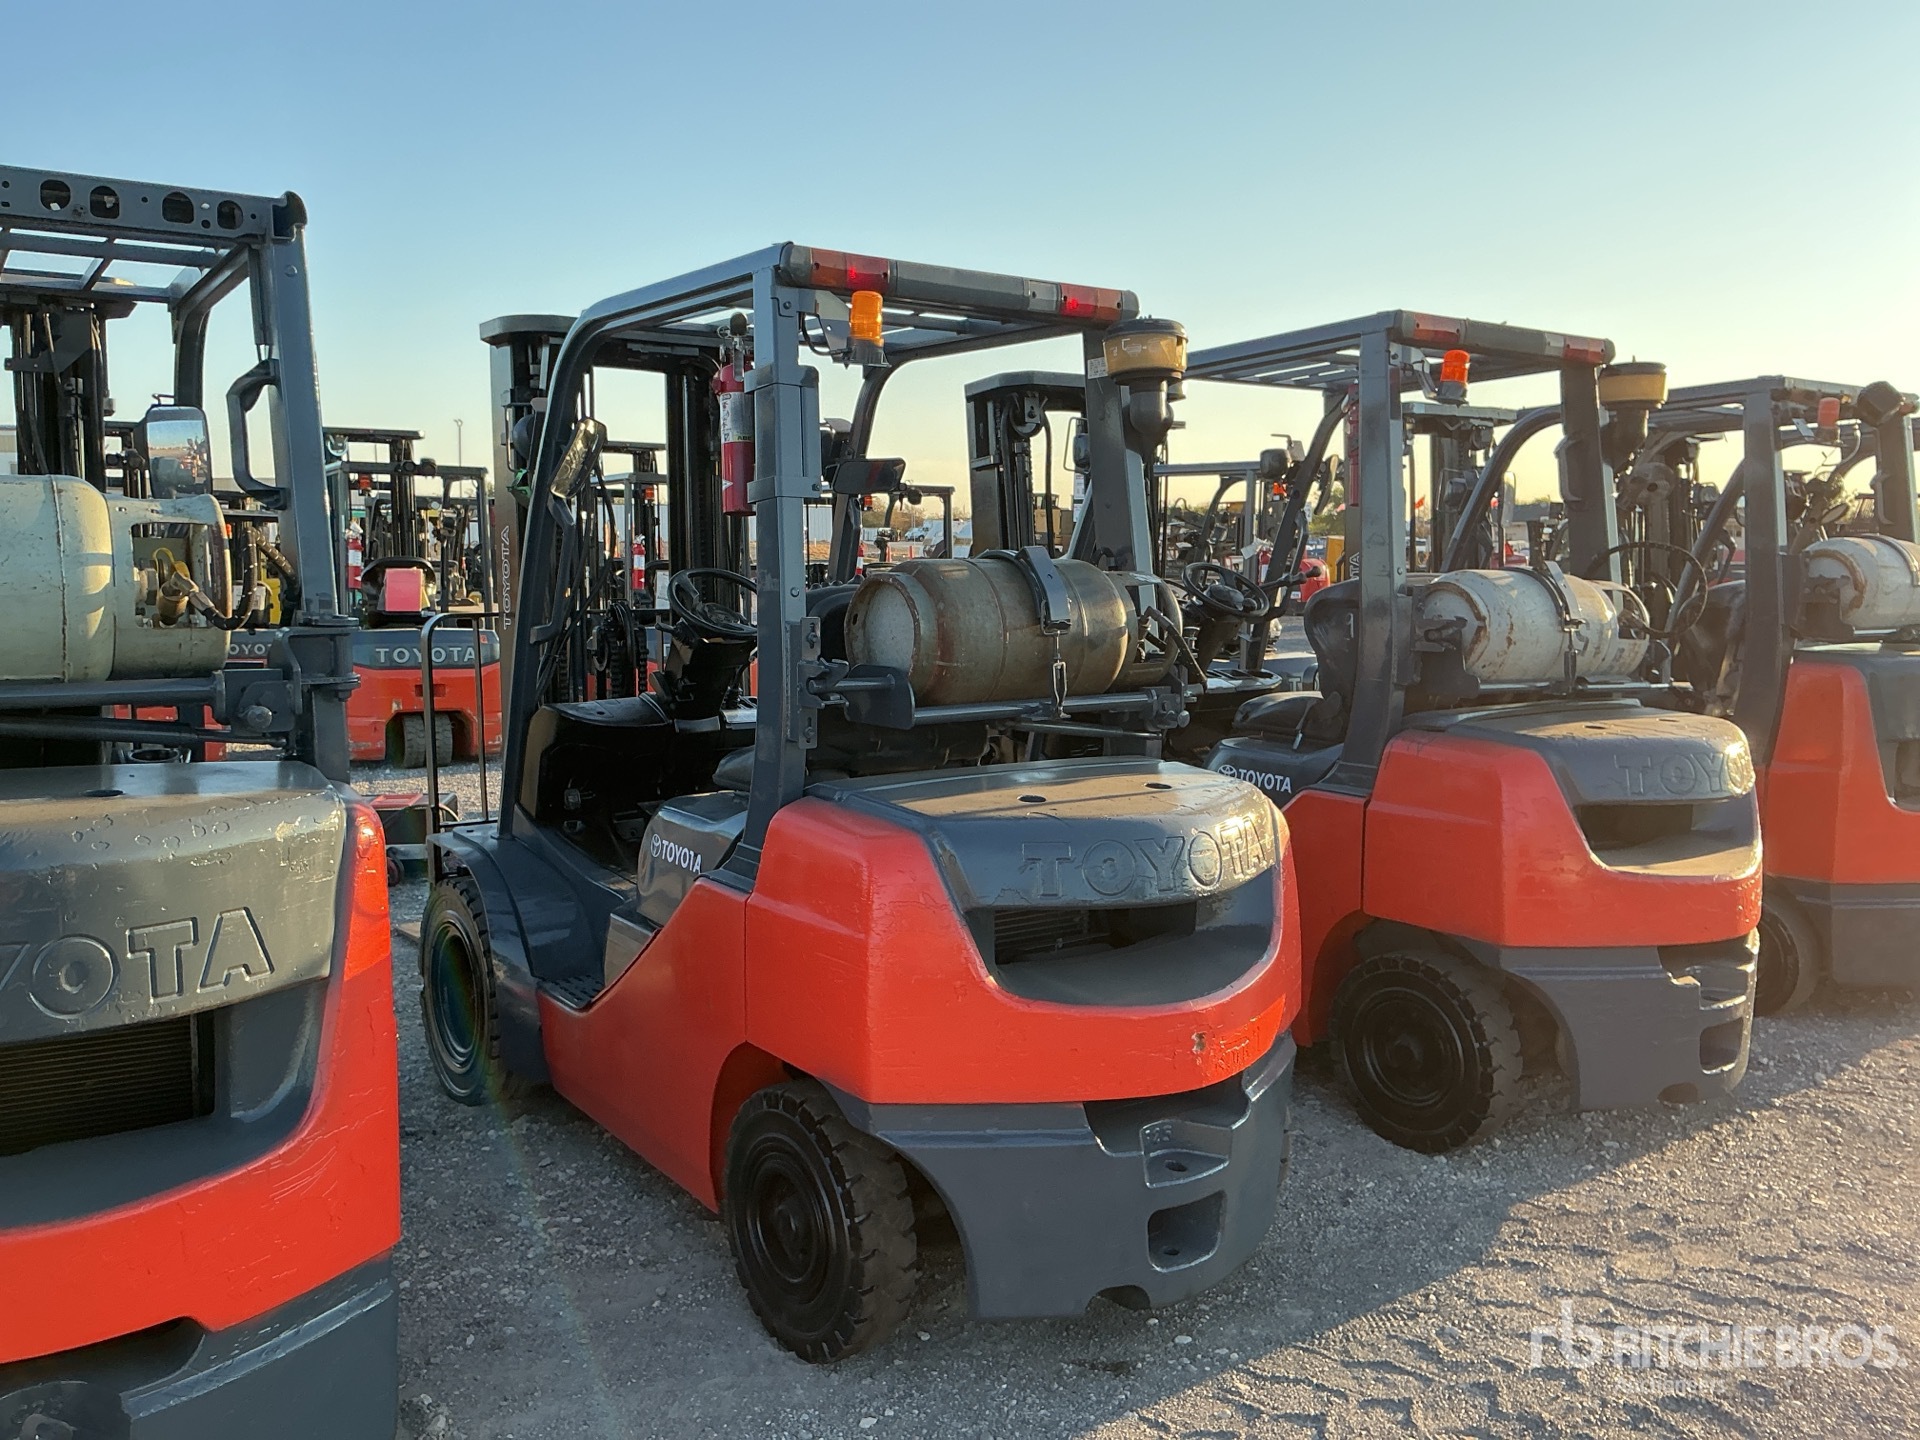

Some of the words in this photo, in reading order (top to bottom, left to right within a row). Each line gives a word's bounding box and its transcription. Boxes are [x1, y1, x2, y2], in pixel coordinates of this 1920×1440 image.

[501, 525, 511, 630] TOYOTA
[229, 643, 272, 655] OYO
[1239, 768, 1292, 794] TOYOTA
[662, 839, 702, 875] TOYOTA
[1022, 814, 1266, 897] TOYOTA
